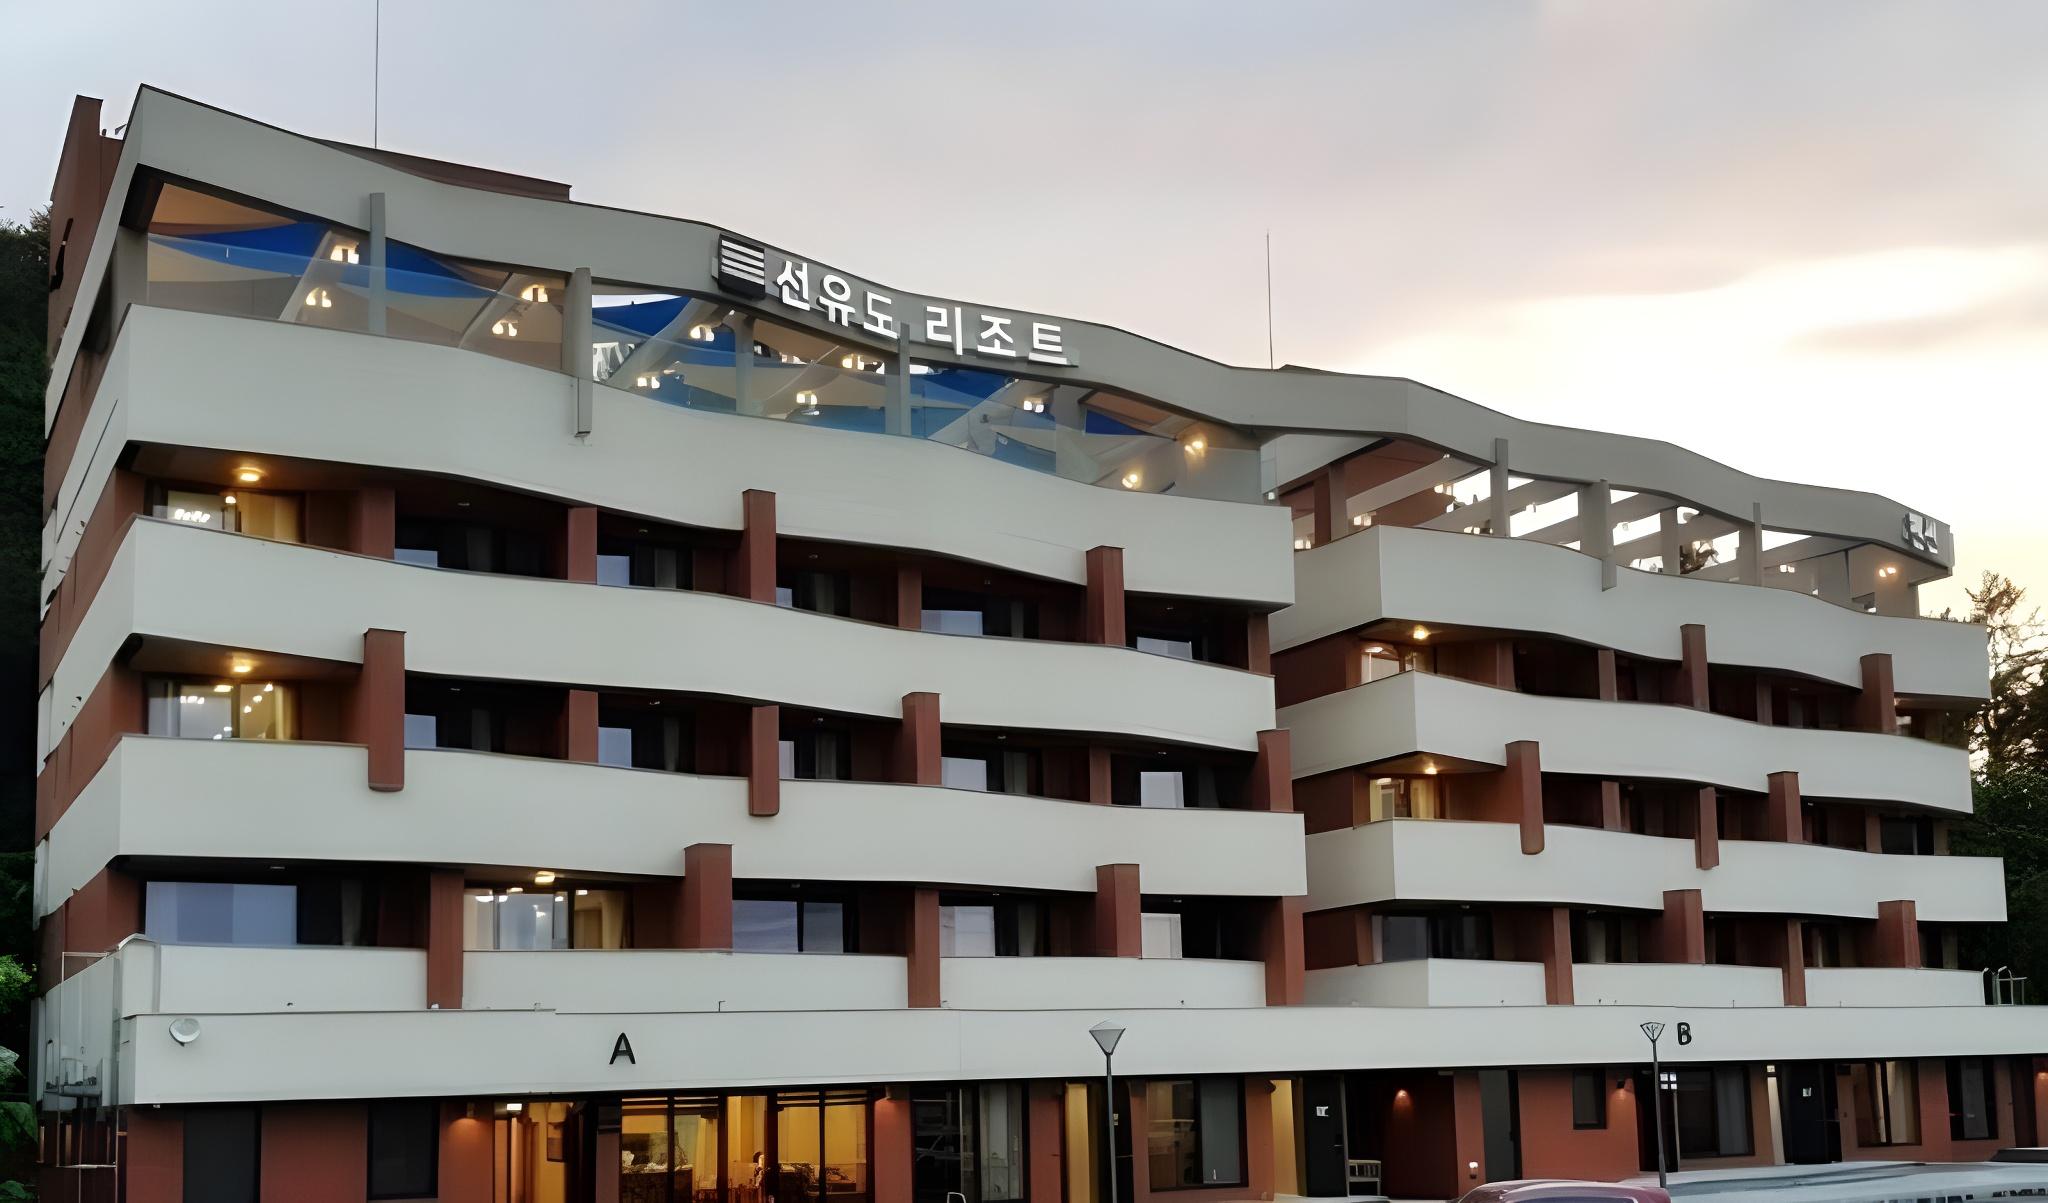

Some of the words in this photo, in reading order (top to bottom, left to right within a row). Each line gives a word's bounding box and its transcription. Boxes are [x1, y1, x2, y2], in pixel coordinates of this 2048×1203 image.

[776, 260, 898, 339] 선유도
[926, 305, 1068, 365] 리조트
[609, 1032, 636, 1065] A
[1677, 1022, 1692, 1045] B
